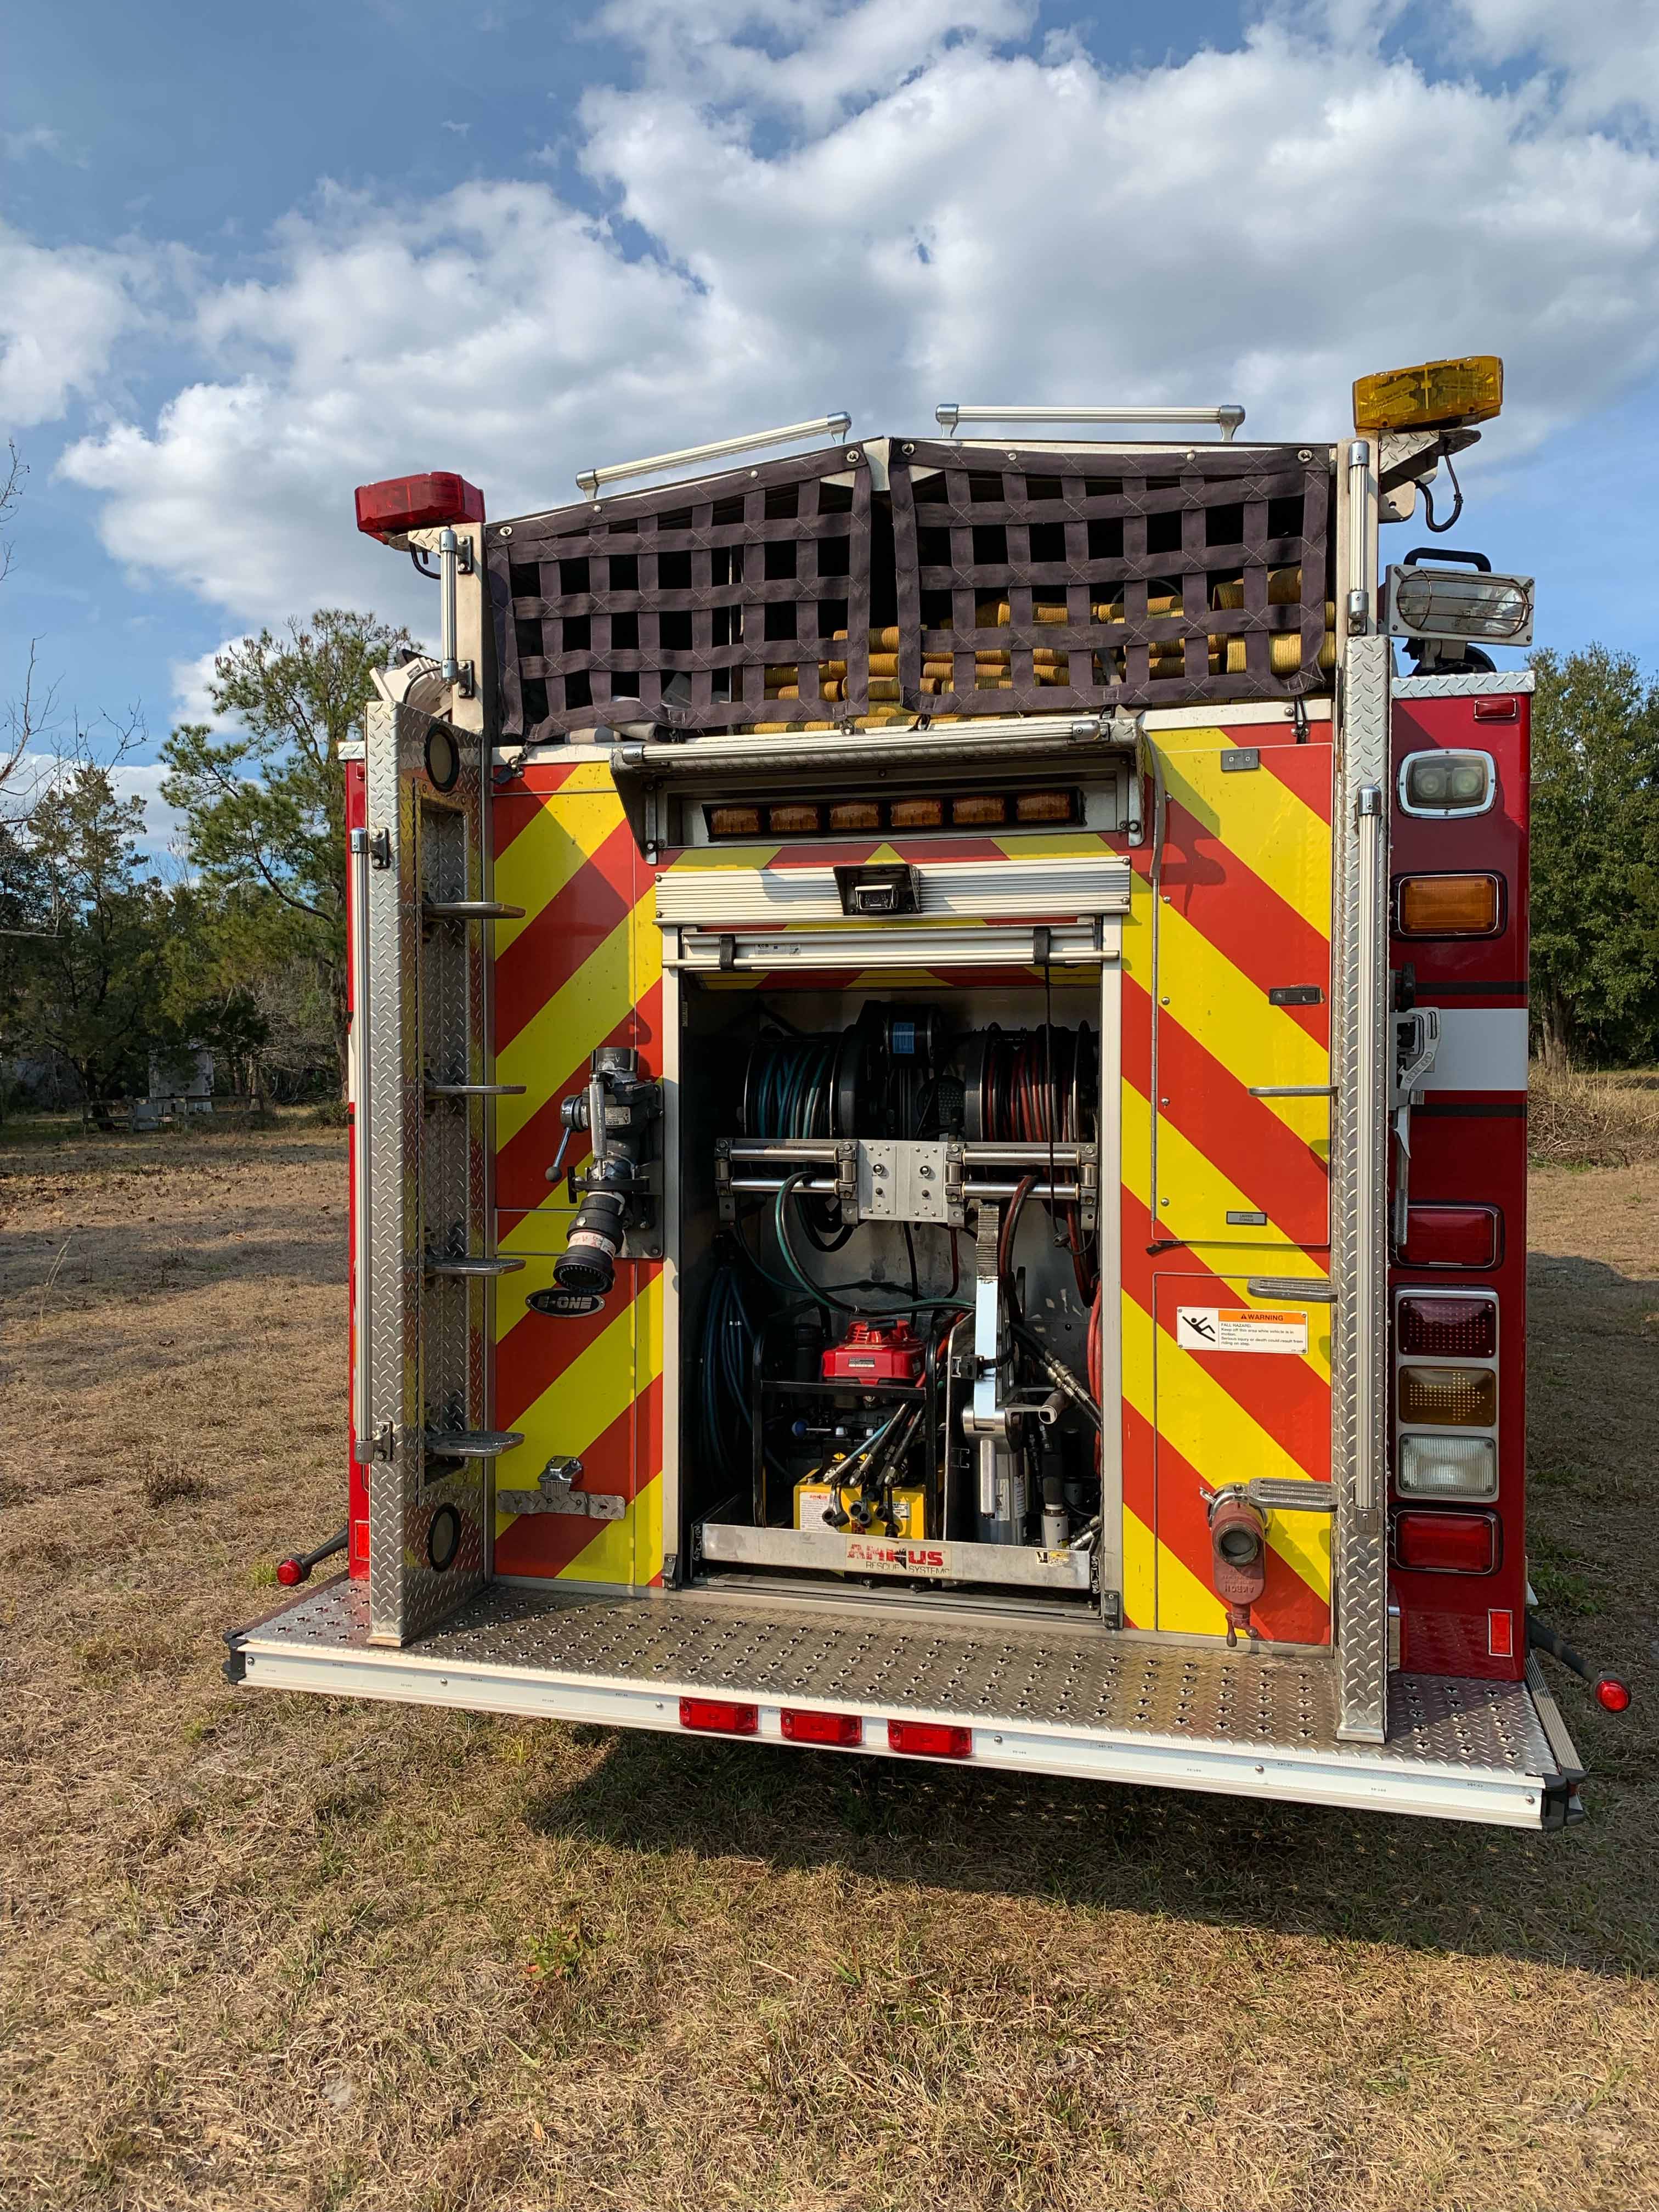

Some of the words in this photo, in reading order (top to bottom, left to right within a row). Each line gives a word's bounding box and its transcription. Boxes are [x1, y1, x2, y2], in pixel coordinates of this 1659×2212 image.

[538, 1296, 592, 1309] E-ONE
[847, 1543, 944, 1567] AMKUS
[866, 1561, 900, 1572] RESCUE
[909, 1565, 950, 1575] SYSTEMS
